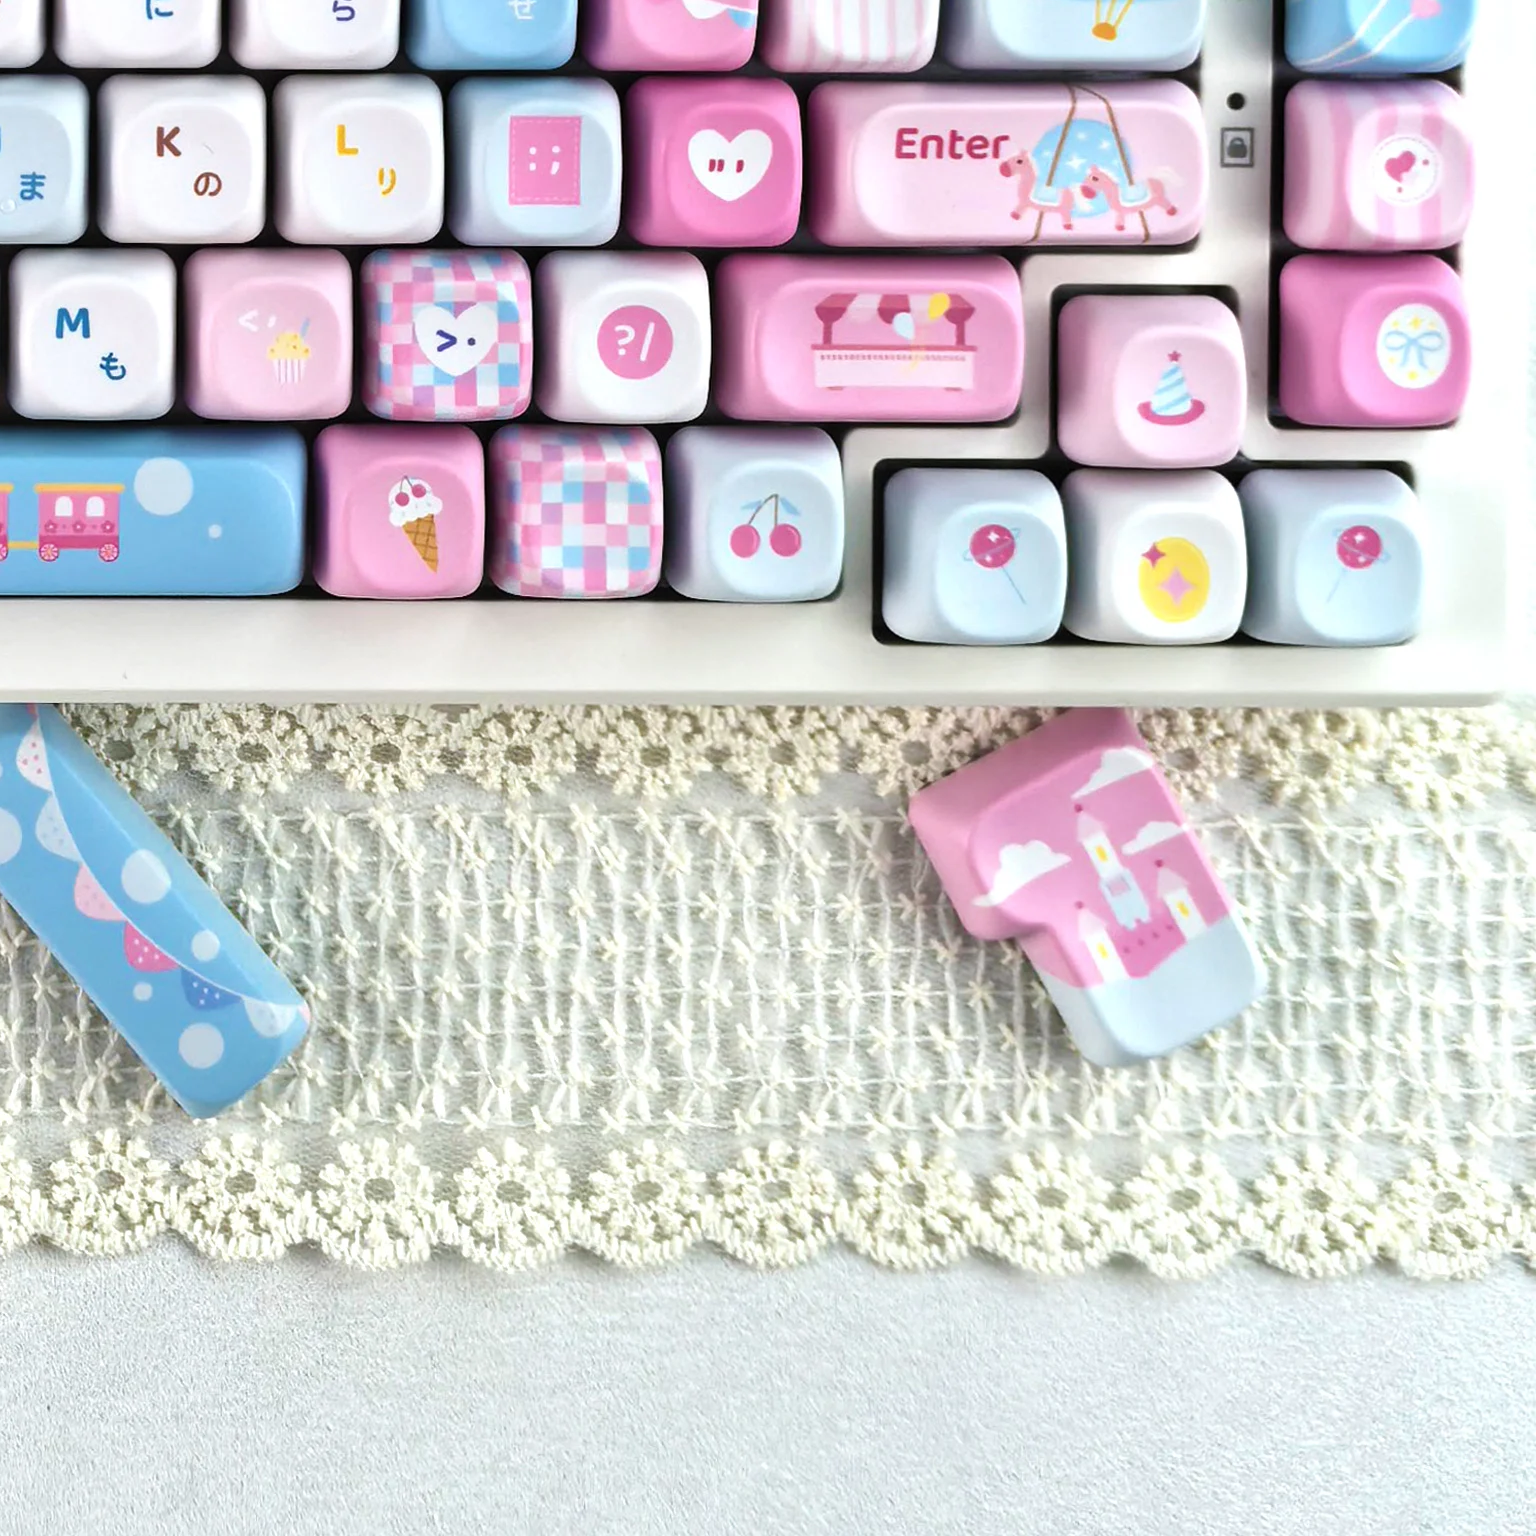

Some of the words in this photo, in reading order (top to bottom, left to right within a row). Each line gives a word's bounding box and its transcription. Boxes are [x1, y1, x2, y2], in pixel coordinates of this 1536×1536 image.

[155, 124, 183, 159] K
[335, 124, 360, 157] L
[894, 125, 1012, 161] Enter
[19, 170, 48, 202] ま
[192, 170, 223, 198] の
[377, 166, 398, 196] り
[54, 306, 92, 340] M
[100, 351, 128, 383] も
